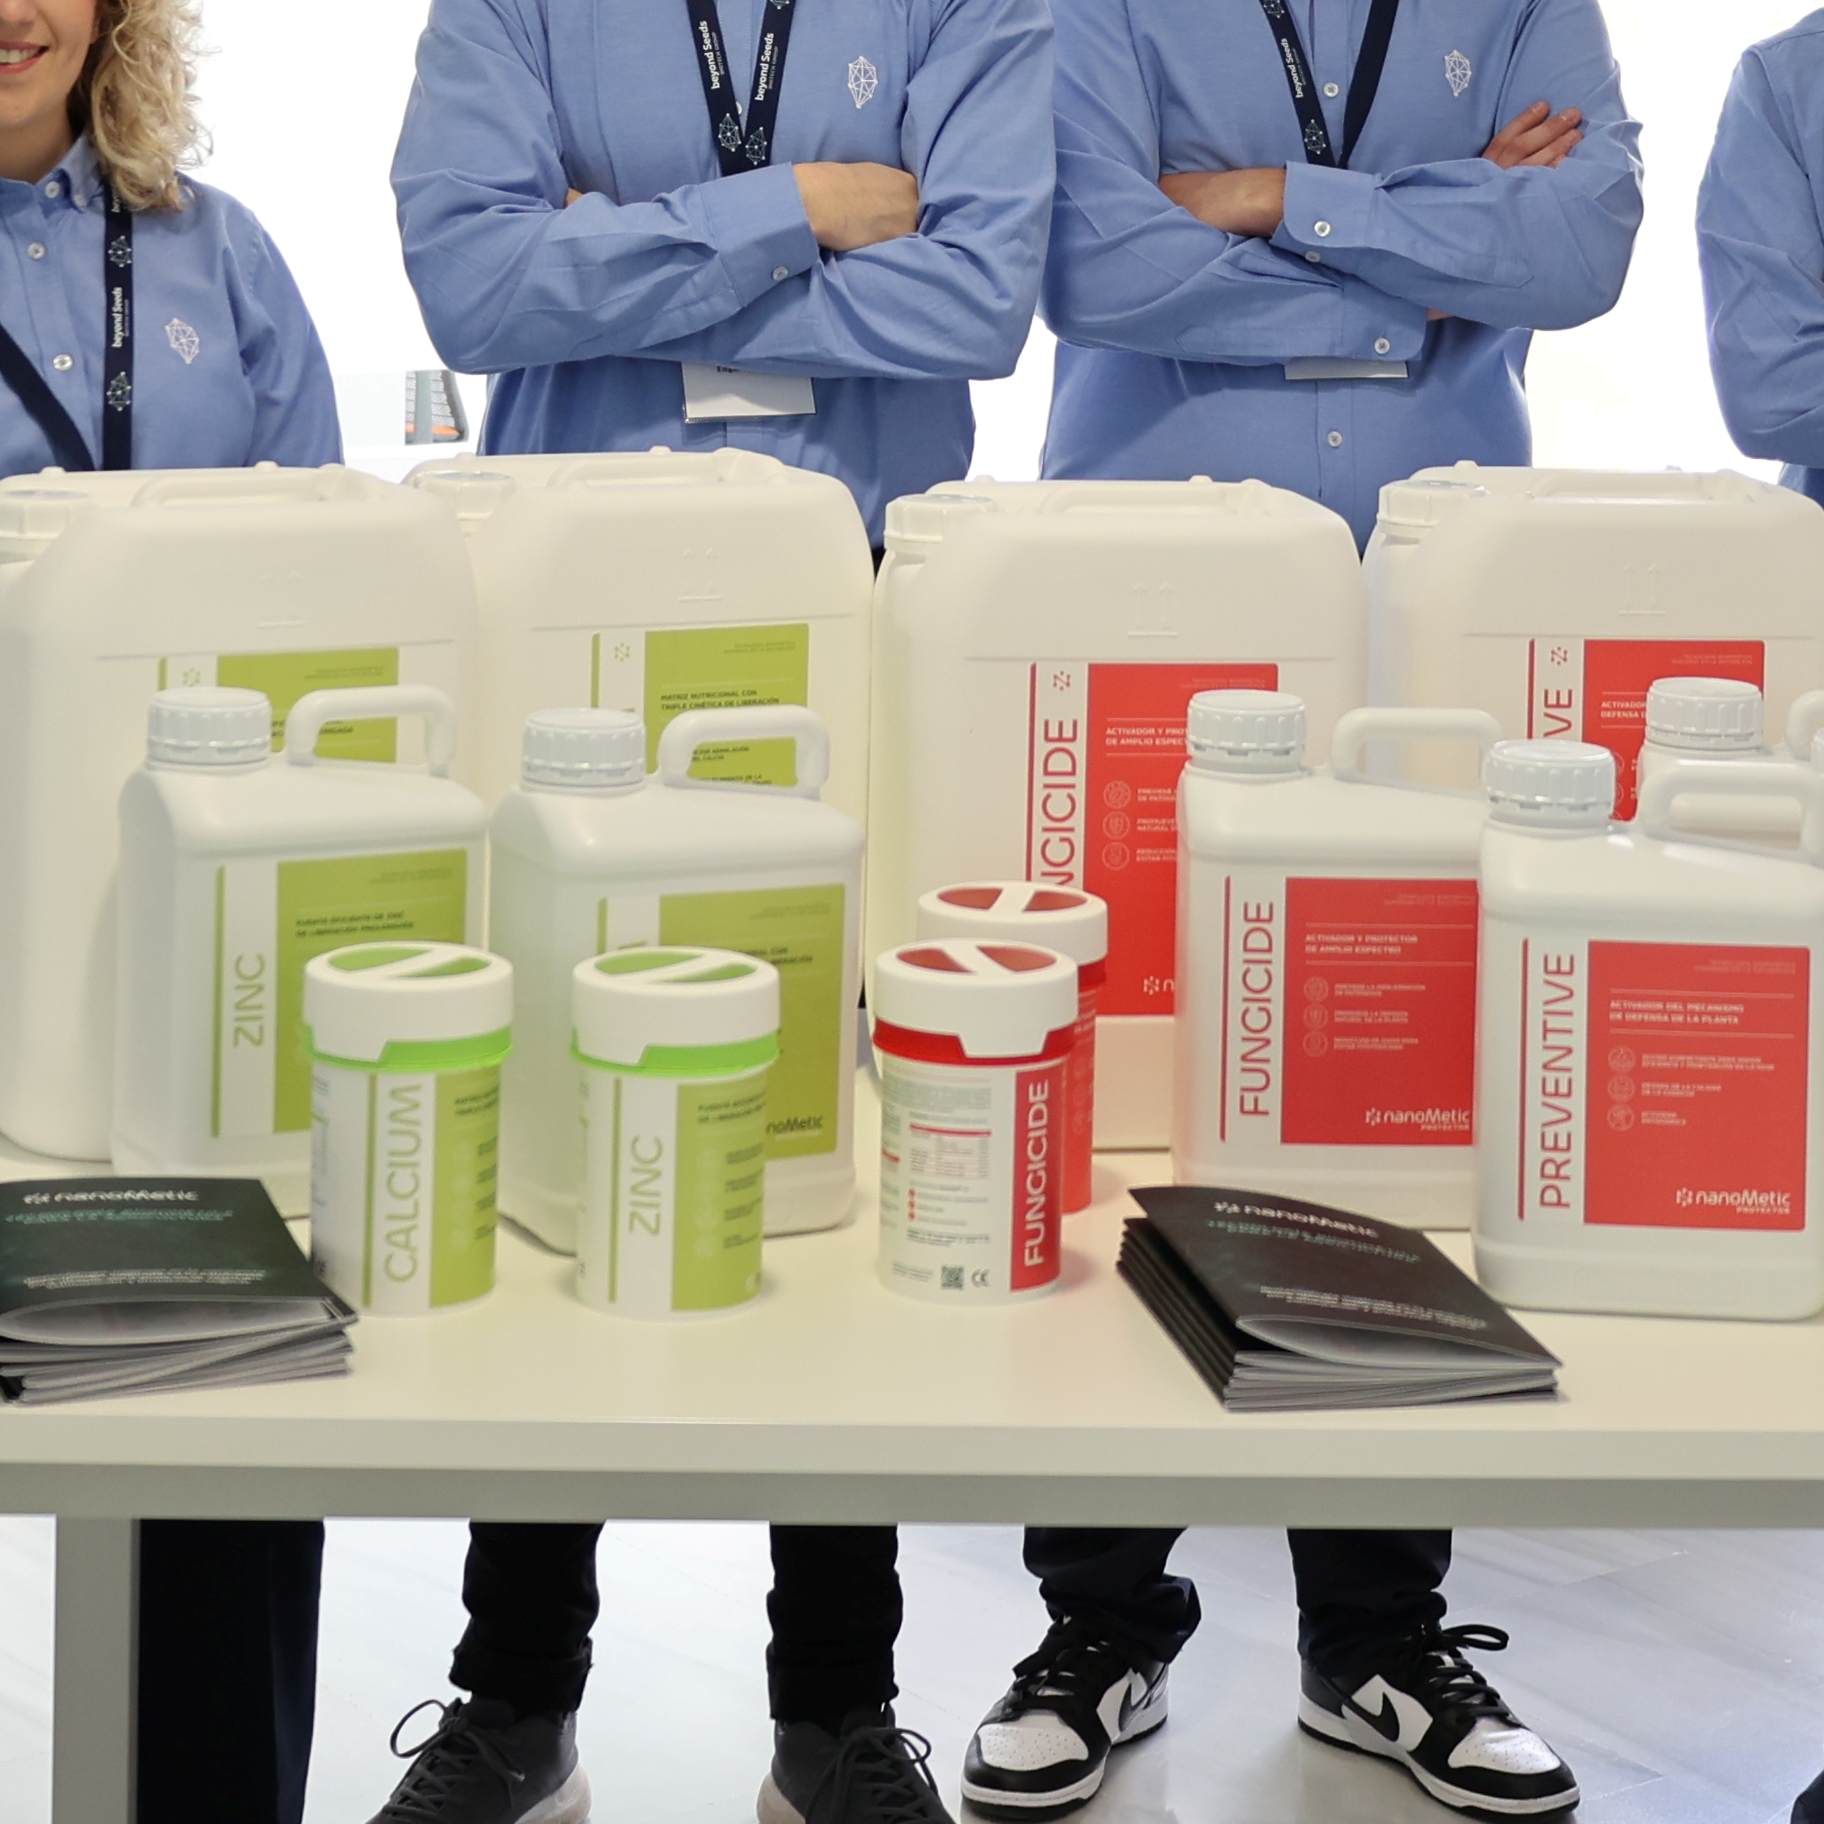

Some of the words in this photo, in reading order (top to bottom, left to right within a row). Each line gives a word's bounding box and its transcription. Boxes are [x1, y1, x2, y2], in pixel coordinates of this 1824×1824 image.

[698, 20, 712, 51] Seeds
[761, 32, 774, 62] Seeds
[704, 52, 720, 89] beyond
[755, 63, 769, 101] beyond
[1288, 64, 1304, 98] beyond
[112, 287, 123, 312] Seeds
[112, 313, 125, 347] beyond
[1105, 727, 1155, 736] ACTIVADOR
[1157, 727, 1164, 736] Y
[1105, 737, 1118, 746] DE
[1119, 737, 1153, 746] AMPLIO
[1155, 737, 1187, 746] ESPEC
[1040, 719, 1078, 886] NGICIDE
[233, 954, 265, 1048] ZINC
[1239, 902, 1274, 1116] FUNGICIDE
[1539, 954, 1574, 1208] PREVENTIVE
[766, 1115, 823, 1135] noMetic
[1384, 1107, 1470, 1125] nanoMetic
[384, 1084, 422, 1282] CALCIUM
[628, 1136, 663, 1237] ZINC
[1024, 1079, 1049, 1267] FUNGICIDE
[1695, 1189, 1791, 1207] nanoMetic
